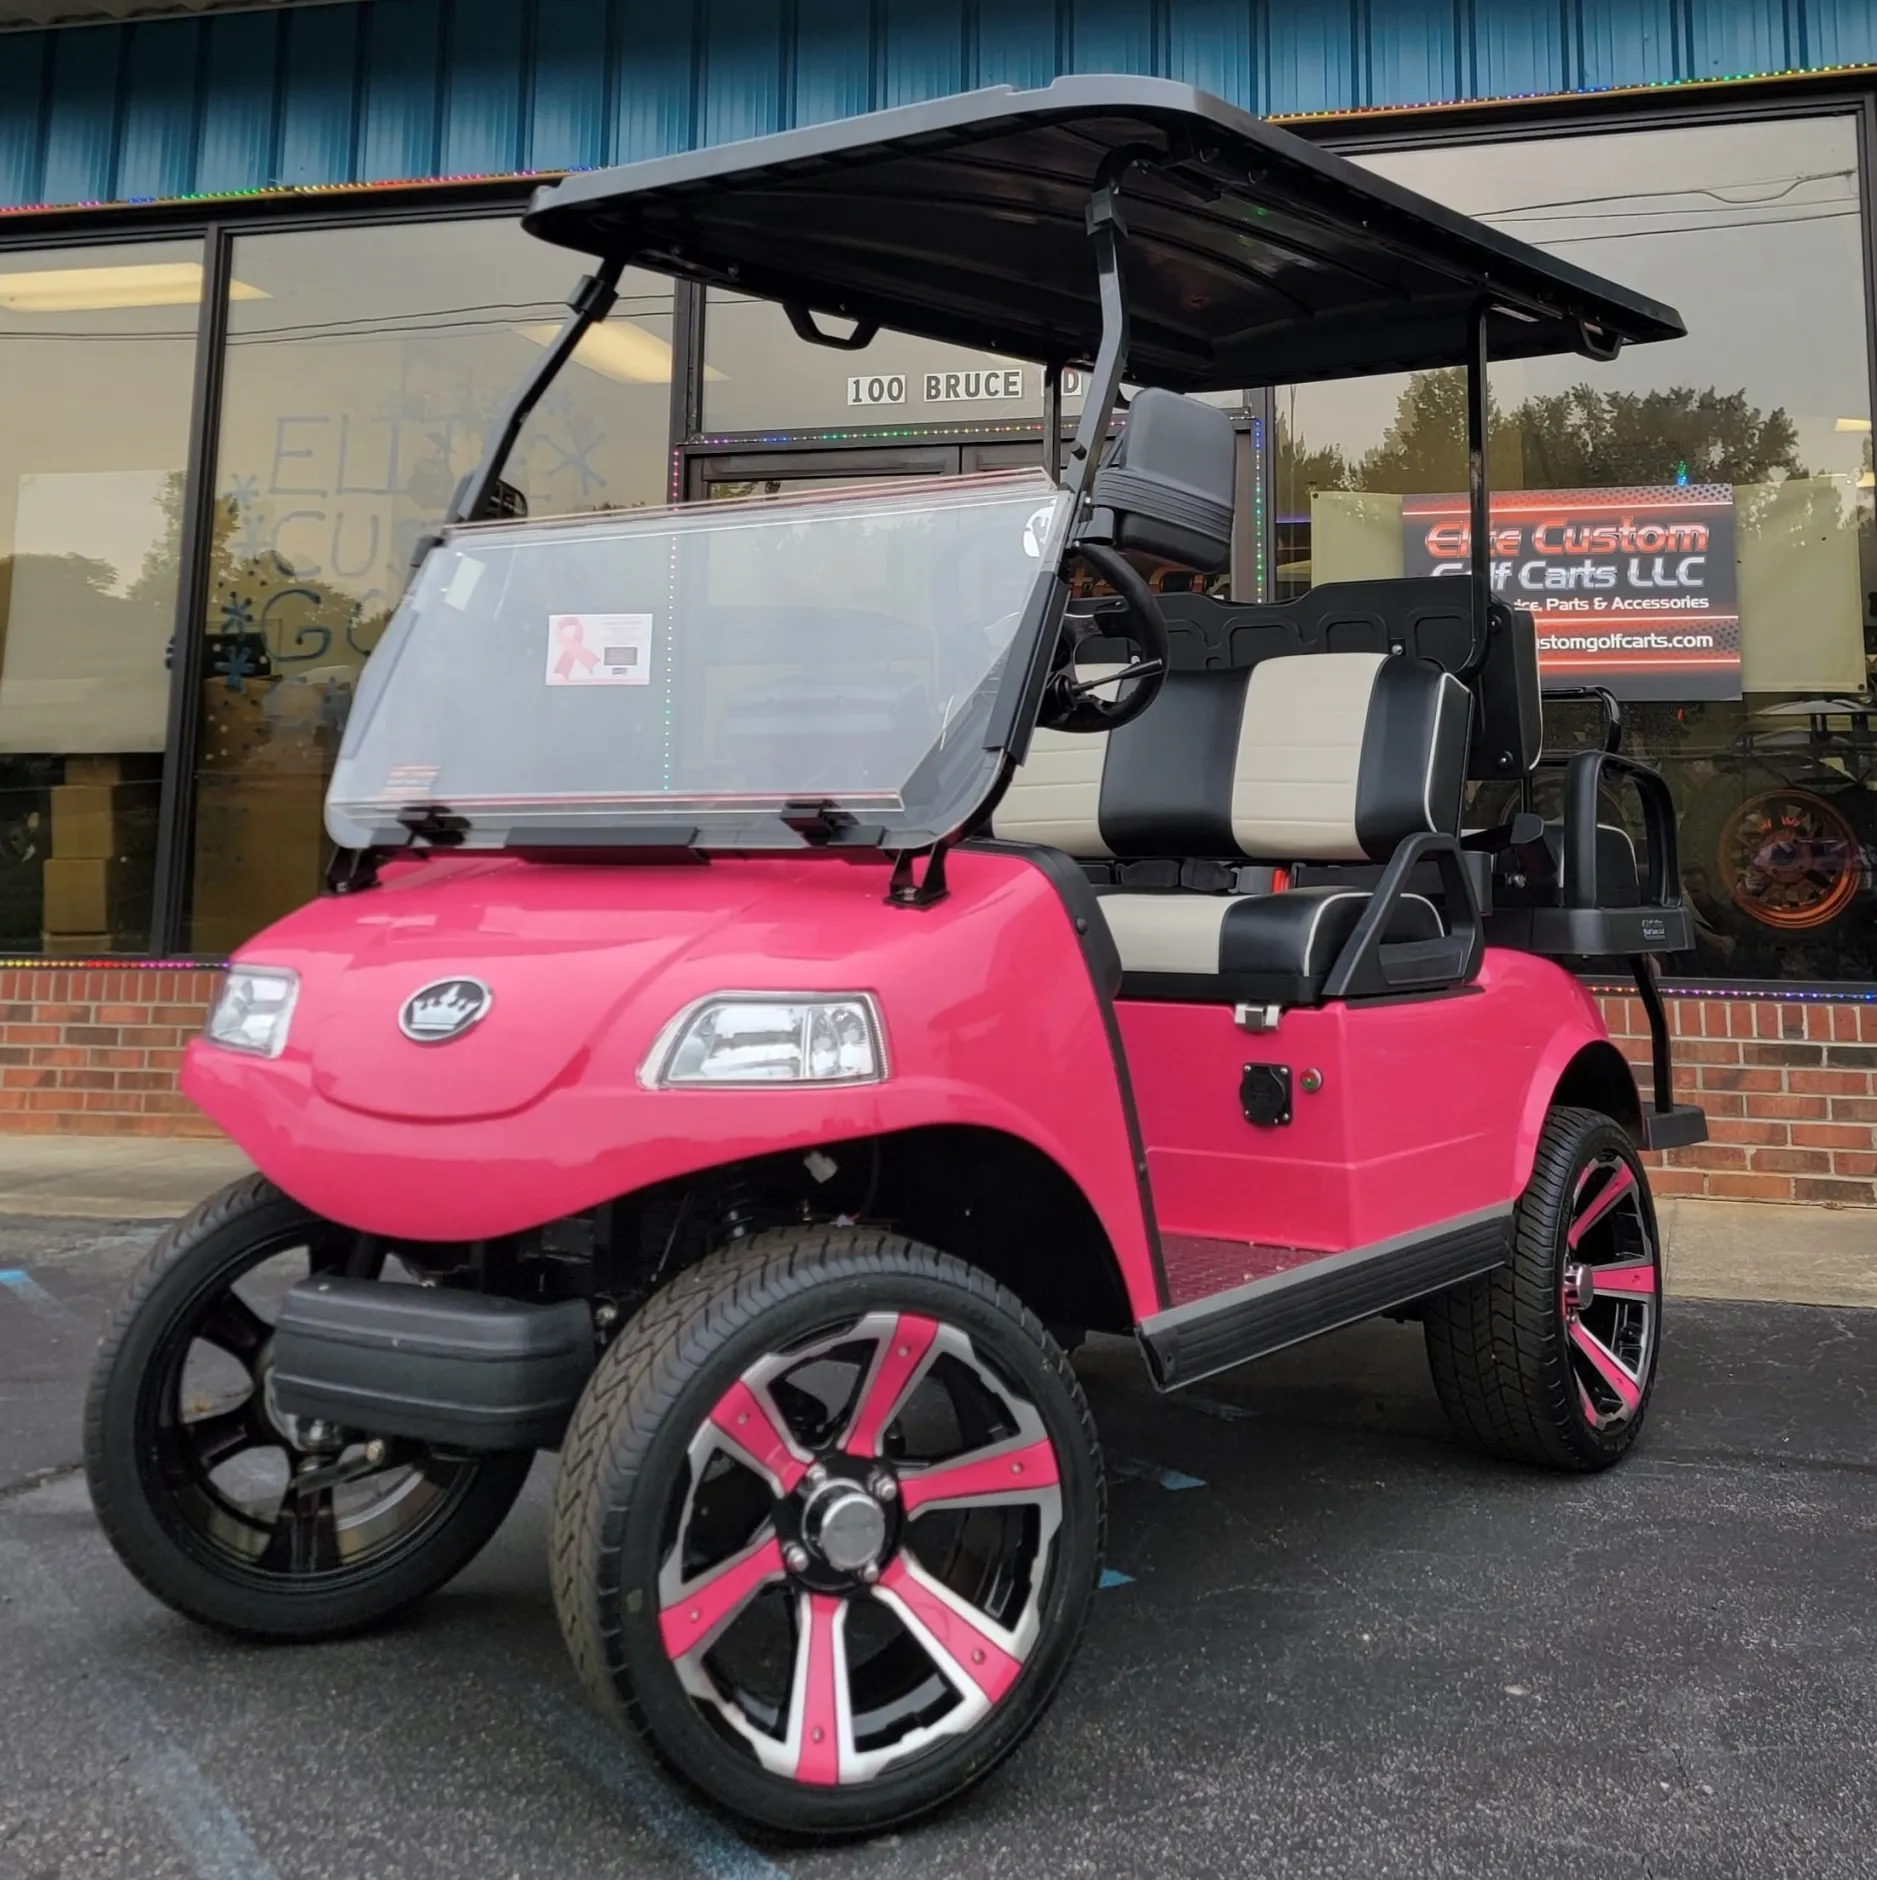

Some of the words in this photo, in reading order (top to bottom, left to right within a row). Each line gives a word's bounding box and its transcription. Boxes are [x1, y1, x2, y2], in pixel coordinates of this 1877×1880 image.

[852, 377, 904, 403] 100
[926, 371, 1020, 400] BRUCE
[1063, 370, 1080, 394] D
[1424, 520, 1521, 559] Elte
[1531, 516, 1710, 555] Custom
[1519, 558, 1618, 590] Carts
[1627, 555, 1707, 588] LLC
[1546, 597, 1590, 611] Parts
[1593, 597, 1608, 611] &
[1611, 595, 1710, 611] Accessories
[1537, 633, 1714, 653] stomgolfcarts.com
